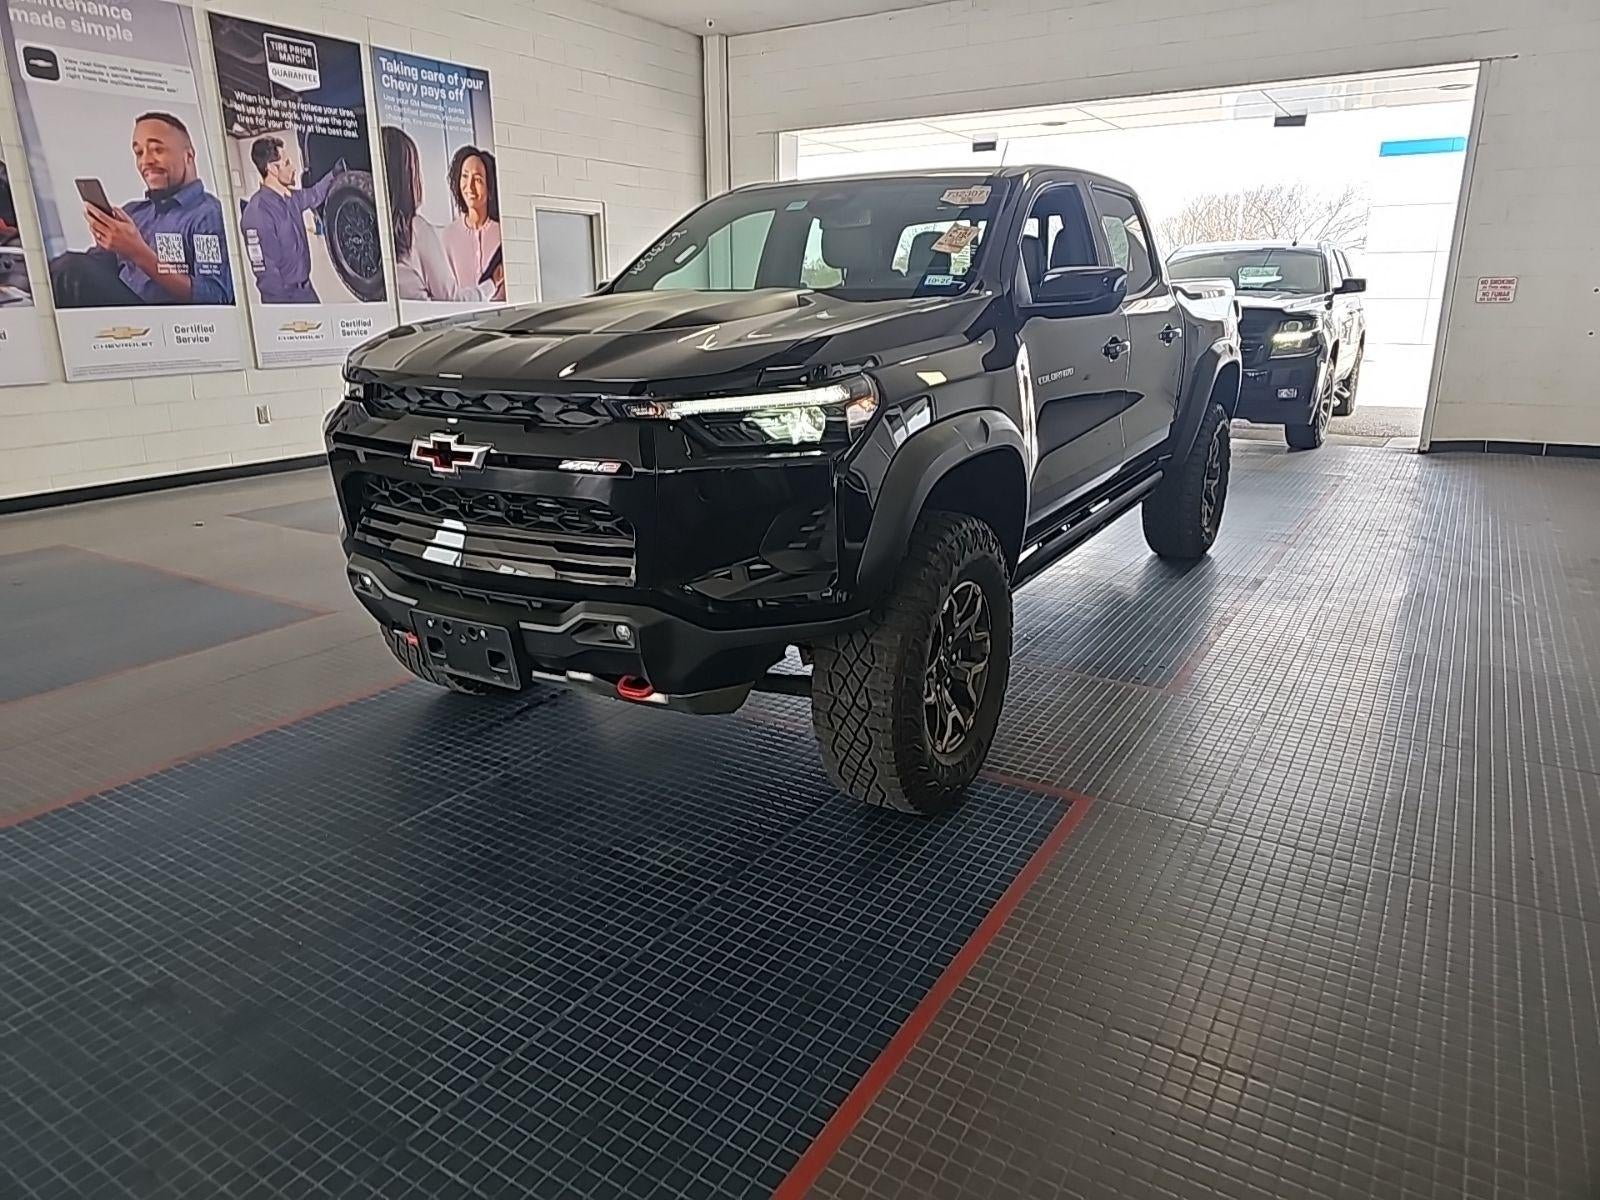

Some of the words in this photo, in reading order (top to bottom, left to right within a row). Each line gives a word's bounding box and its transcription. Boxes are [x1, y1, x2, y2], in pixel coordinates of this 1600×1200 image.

[8, 8, 66, 29] made
[70, 16, 133, 42] simple
[270, 41, 288, 52] TIRE
[289, 44, 313, 58] PRICE
[279, 52, 306, 65] MATCH
[271, 68, 318, 83] GUARANTEE
[379, 56, 418, 80] Taking
[421, 69, 445, 83] care
[447, 73, 459, 86] of
[460, 77, 484, 91] your
[381, 74, 418, 97] Chevy
[421, 84, 446, 100] pays
[448, 89, 464, 102] off
[234, 91, 257, 102] When
[258, 93, 269, 103] it's
[271, 96, 288, 108] time
[289, 100, 297, 109] to
[298, 101, 322, 113] replace
[323, 107, 338, 116] your
[339, 107, 355, 118] tires,
[247, 106, 255, 114] us
[256, 106, 266, 116] do
[268, 107, 279, 116] the
[280, 109, 300, 120] work.
[301, 113, 312, 121] We
[313, 114, 329, 124] have
[330, 115, 342, 125] the
[343, 117, 358, 129] right
[237, 114, 253, 124] tires
[255, 116, 267, 125] for
[267, 120, 283, 129] your
[284, 120, 305, 133] Chevy
[307, 124, 314, 132] at
[315, 124, 327, 134] the
[328, 126, 342, 135] best
[343, 128, 359, 139] deal.
[174, 323, 215, 334] Certified
[340, 319, 372, 328] Certified
[176, 335, 210, 344] Service
[341, 329, 368, 337] Service
